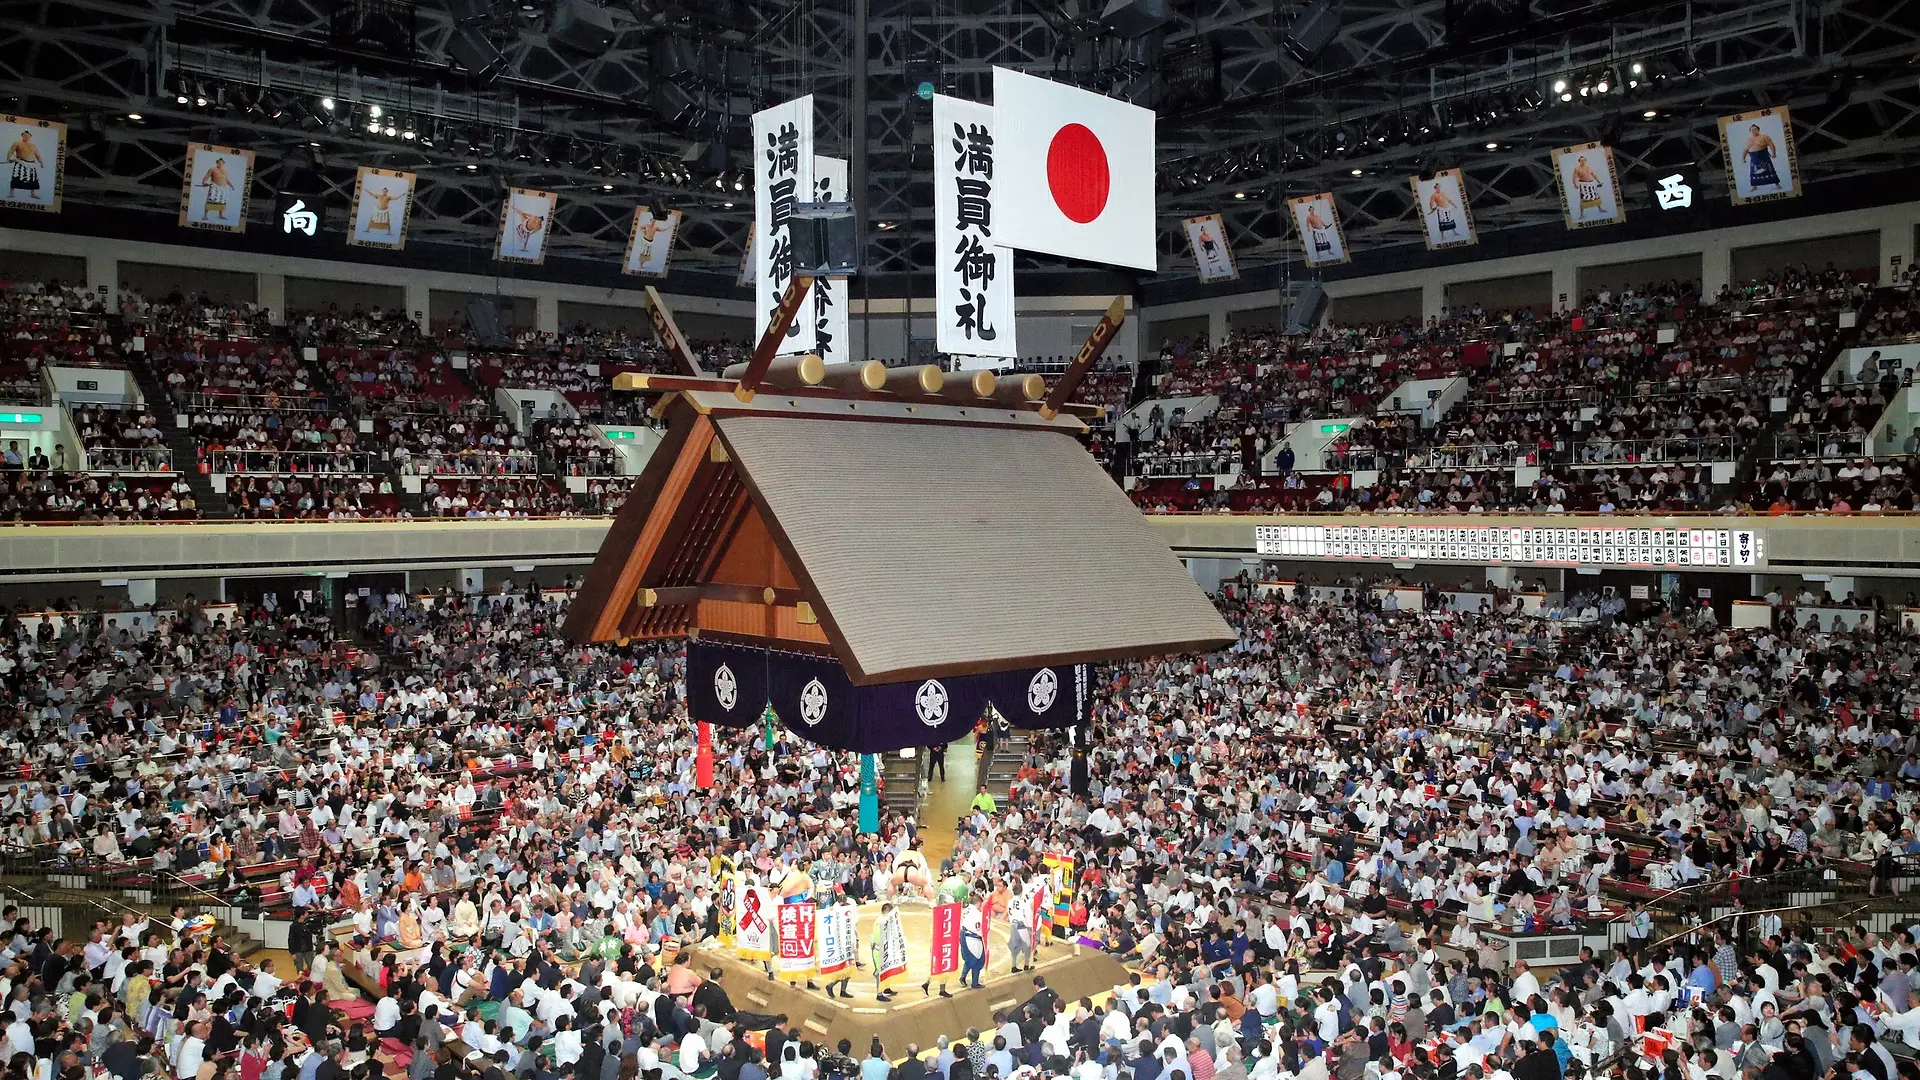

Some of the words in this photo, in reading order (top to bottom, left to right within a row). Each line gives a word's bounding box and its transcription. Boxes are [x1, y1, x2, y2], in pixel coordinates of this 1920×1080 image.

[1655, 173, 1692, 210] 西
[283, 199, 318, 236] 向
[952, 122, 996, 341] 満員御礼
[1738, 532, 1750, 563] 寄り切り
[780, 906, 798, 939] 検査
[799, 905, 813, 956] HIV
[823, 914, 836, 958] オーロラ
